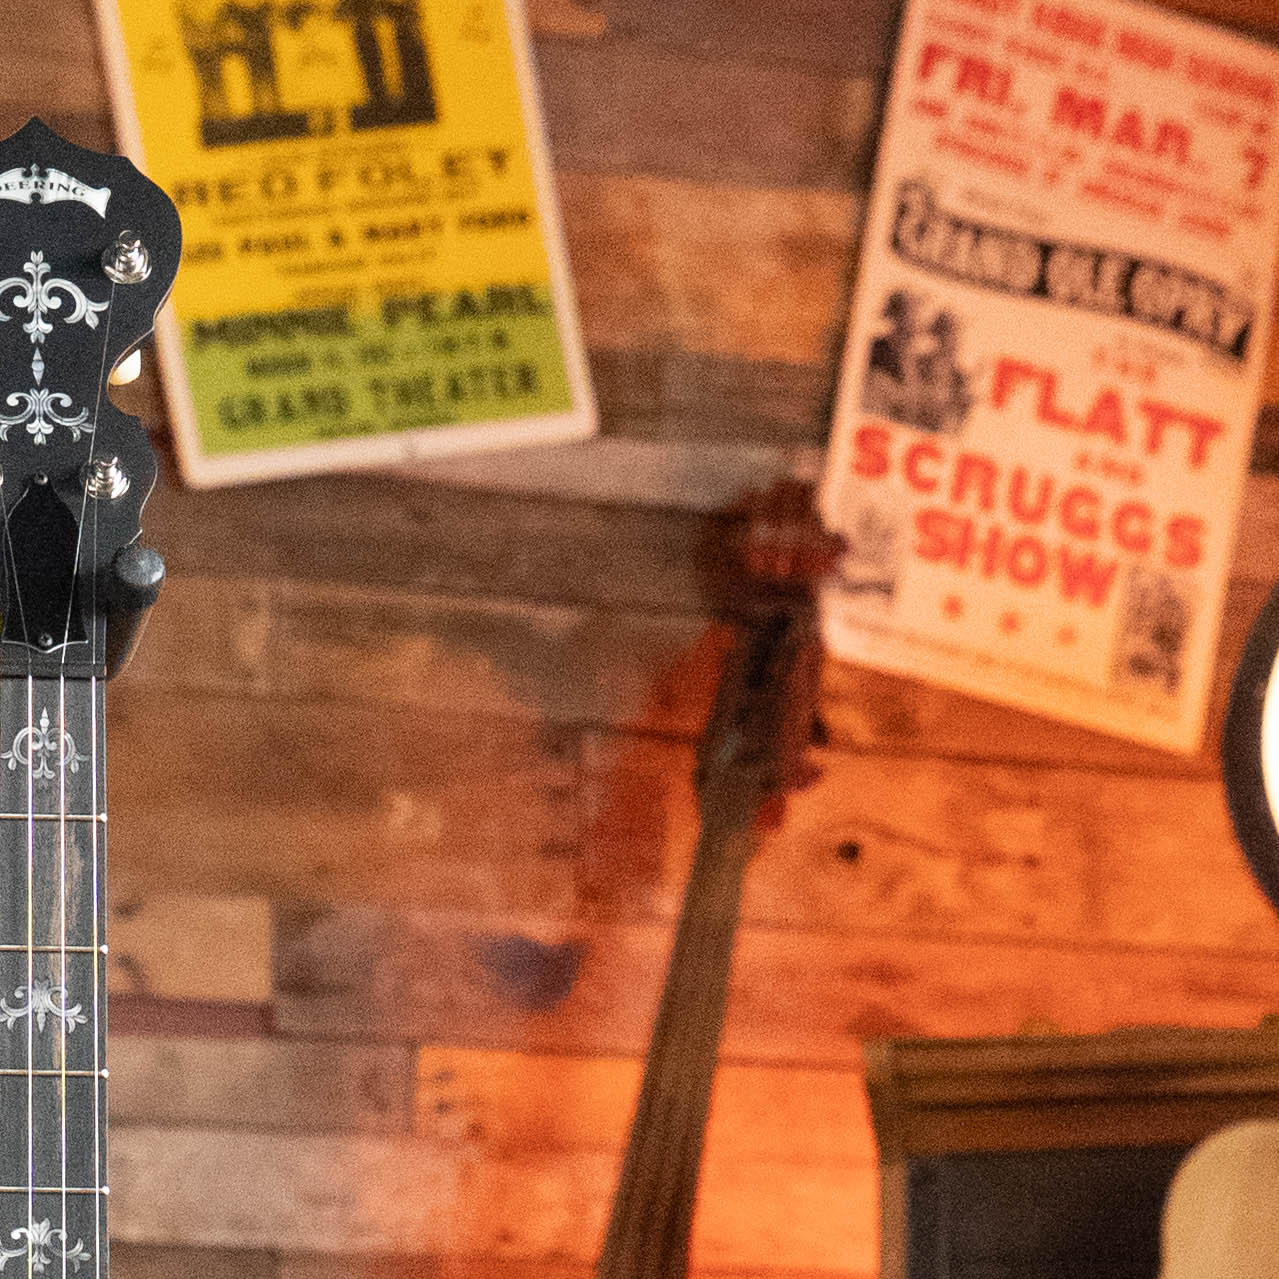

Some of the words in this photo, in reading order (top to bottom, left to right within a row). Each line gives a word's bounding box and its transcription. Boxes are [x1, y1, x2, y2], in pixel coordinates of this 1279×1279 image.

[317, 147, 509, 192] FOLEY
[892, 185, 1039, 296] GRAND
[1048, 244, 1123, 314] OLE
[380, 283, 549, 326] PEARL
[222, 386, 347, 430] GRAND
[369, 362, 539, 404] THEATER
[990, 355, 1223, 469] FLATT
[853, 424, 1205, 568] SCRUGGS
[915, 507, 1116, 609] SHOW
